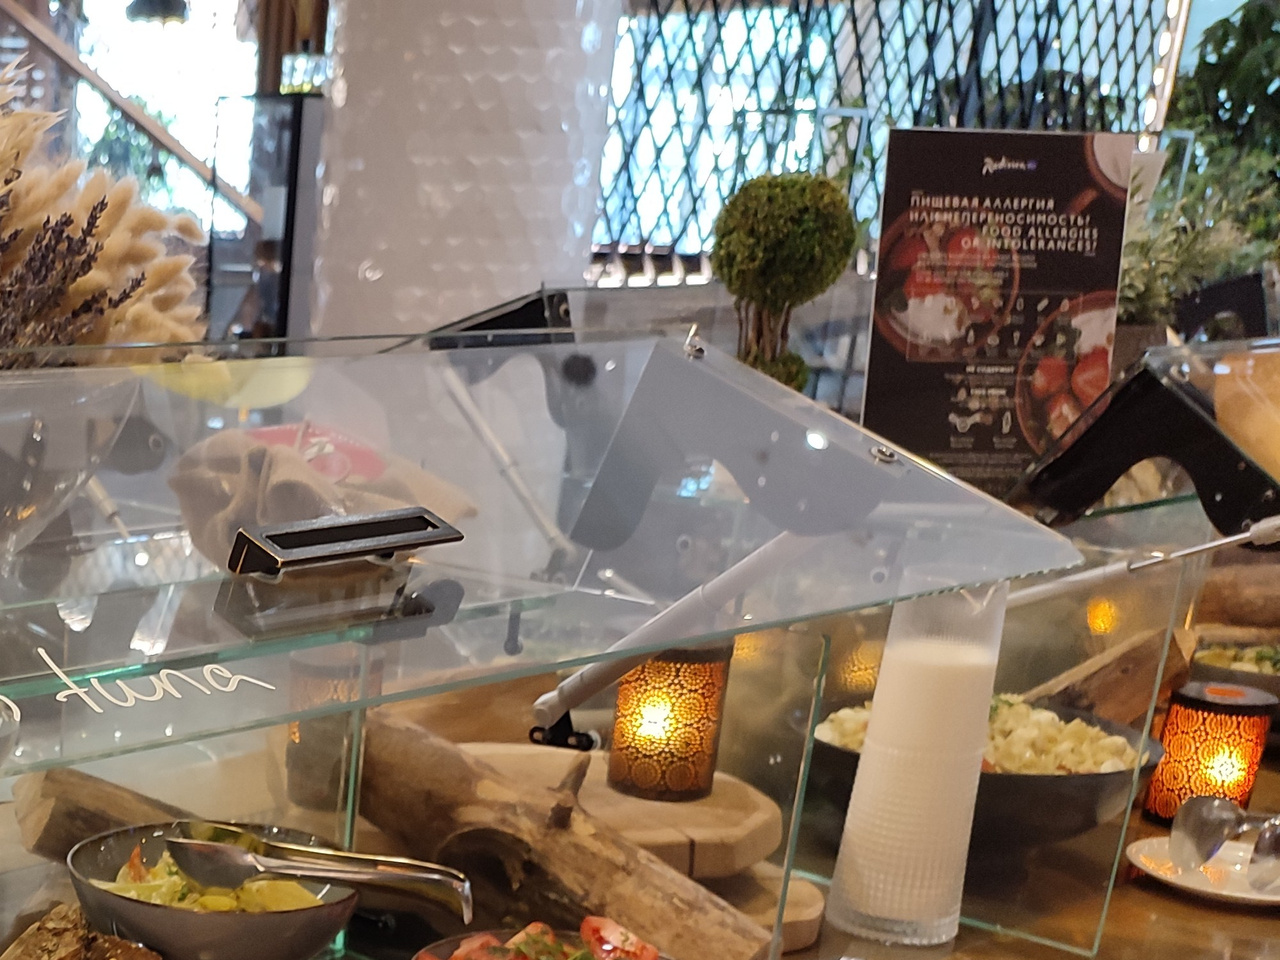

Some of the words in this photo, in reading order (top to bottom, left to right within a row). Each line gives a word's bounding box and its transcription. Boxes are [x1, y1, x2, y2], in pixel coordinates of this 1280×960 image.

[910, 195, 979, 209] ПИЩЕВАЯ
[983, 196, 1055, 211] АЛЛЕРГИЯ
[981, 224, 1022, 237] FOOD
[1027, 225, 1098, 240] ALLERGIES
[37, 647, 278, 714] tuna
